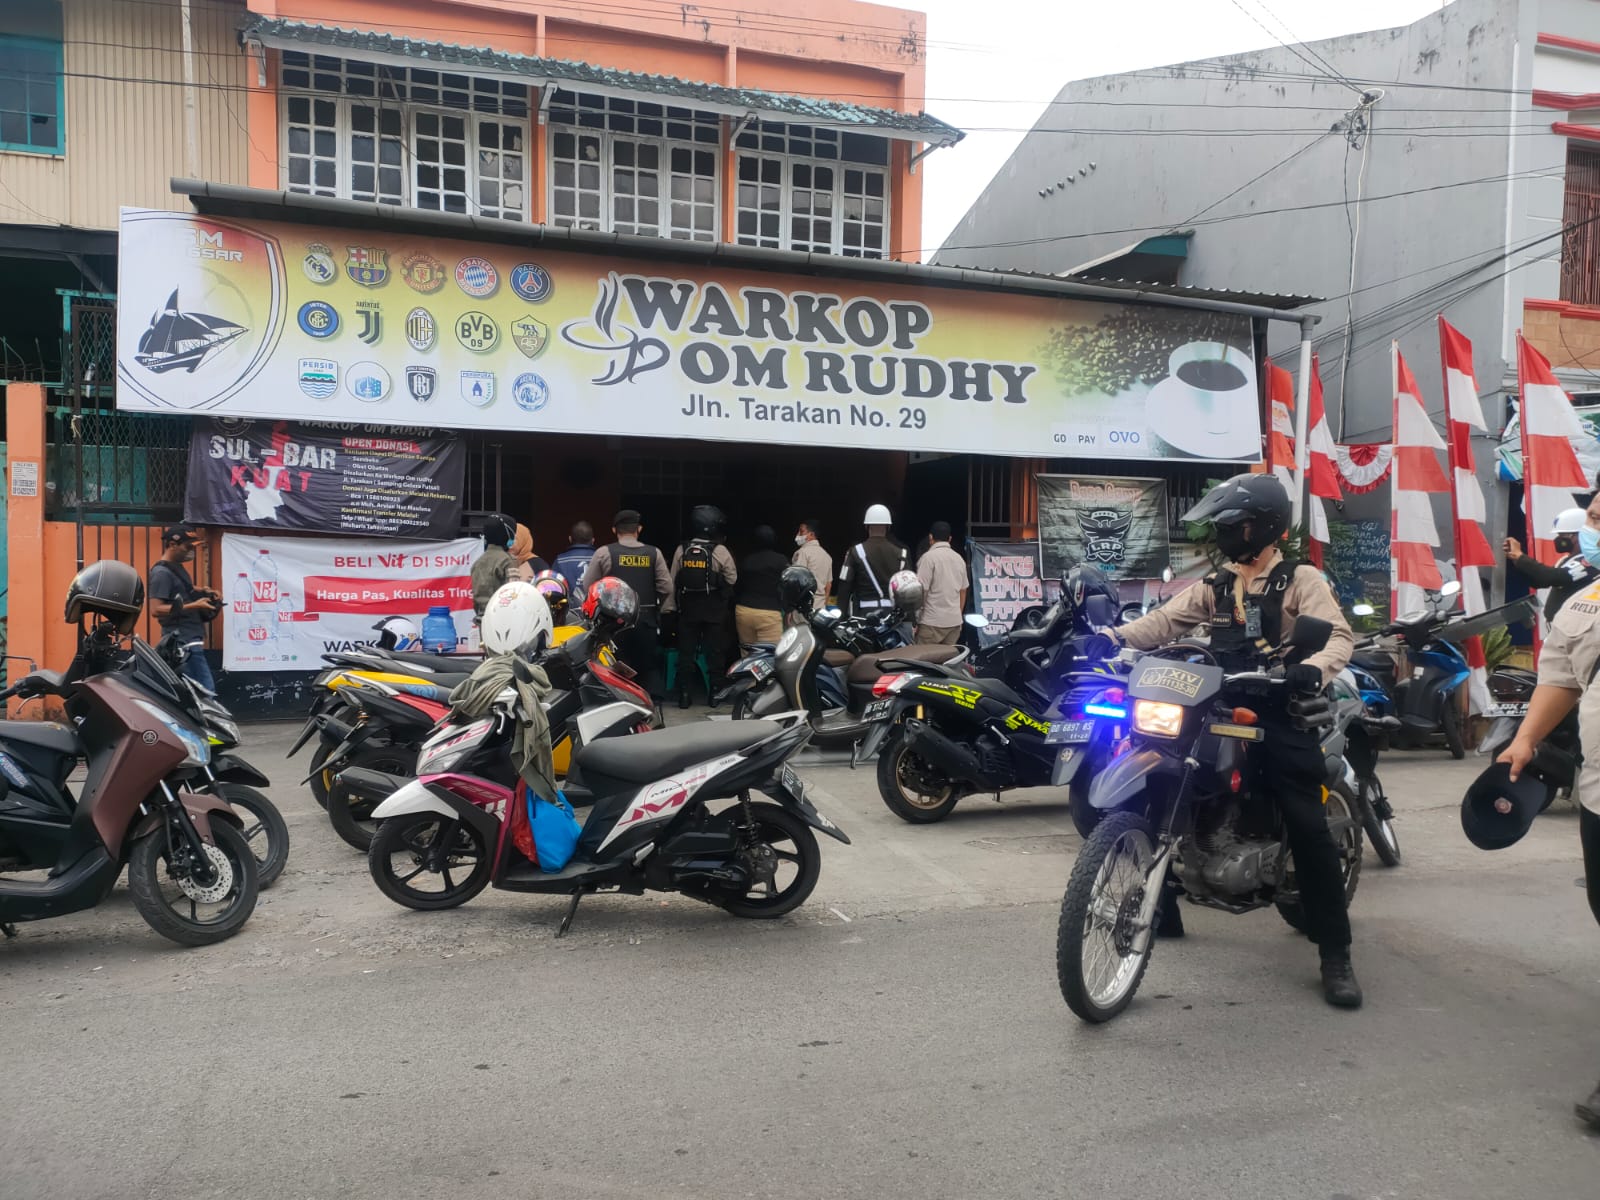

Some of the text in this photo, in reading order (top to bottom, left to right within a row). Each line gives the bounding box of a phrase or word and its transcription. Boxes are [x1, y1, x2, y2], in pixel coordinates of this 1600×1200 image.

[517, 267, 543, 276] PARIS
[622, 278, 930, 349] WARKOP
[461, 315, 493, 340] BVB
[471, 338, 483, 347] 09
[303, 361, 334, 369] PERSIB
[680, 341, 1036, 403] OM RUDHY
[681, 394, 926, 429] Jln. Tarakan No. 29
[345, 437, 413, 451] OPEN DONASI
[1054, 434, 1096, 444] GO PAY
[1109, 431, 1140, 444] OVO
[230, 465, 312, 492] KUAT
[1091, 542, 1122, 550] LRP
[335, 553, 470, 568] BELI Vit DI SINI!
[620, 555, 649, 566] POLISI
[254, 582, 277, 600] Vit
[317, 590, 358, 602] Harga
[362, 590, 389, 602] Pas,
[393, 589, 445, 599] Kualitas
[234, 602, 252, 611] Vit
[1170, 670, 1198, 682] XIV
